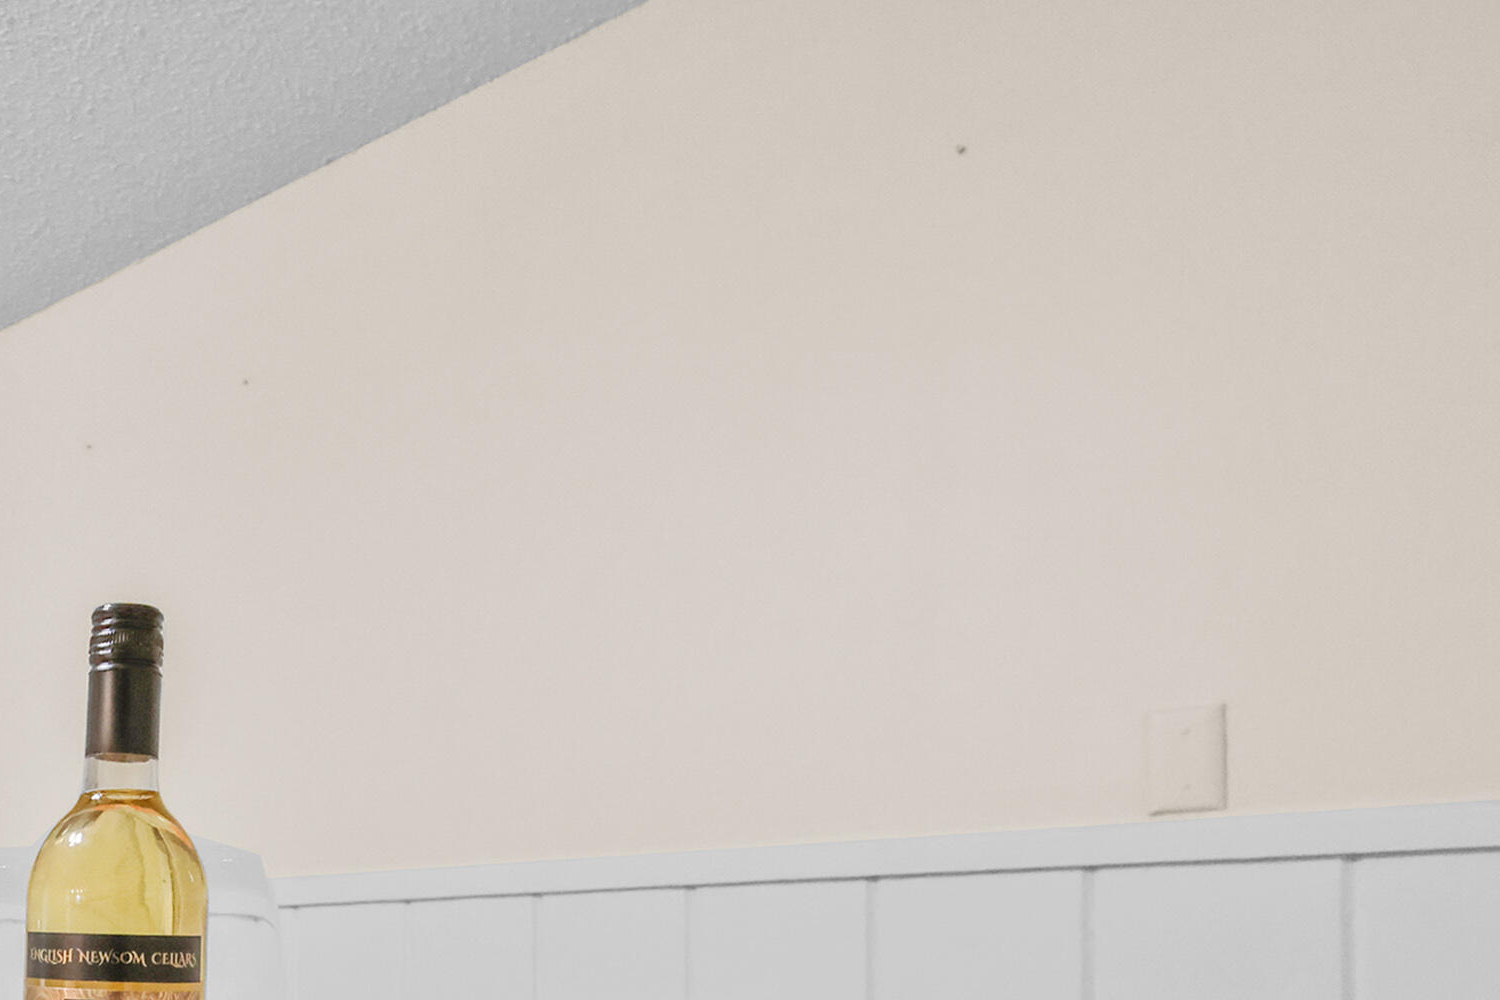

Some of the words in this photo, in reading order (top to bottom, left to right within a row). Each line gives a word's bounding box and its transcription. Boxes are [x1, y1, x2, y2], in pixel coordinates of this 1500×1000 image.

[30, 947, 74, 965] ENGLISH
[76, 948, 147, 967] NEWSOM
[151, 951, 197, 968] CELLARS
